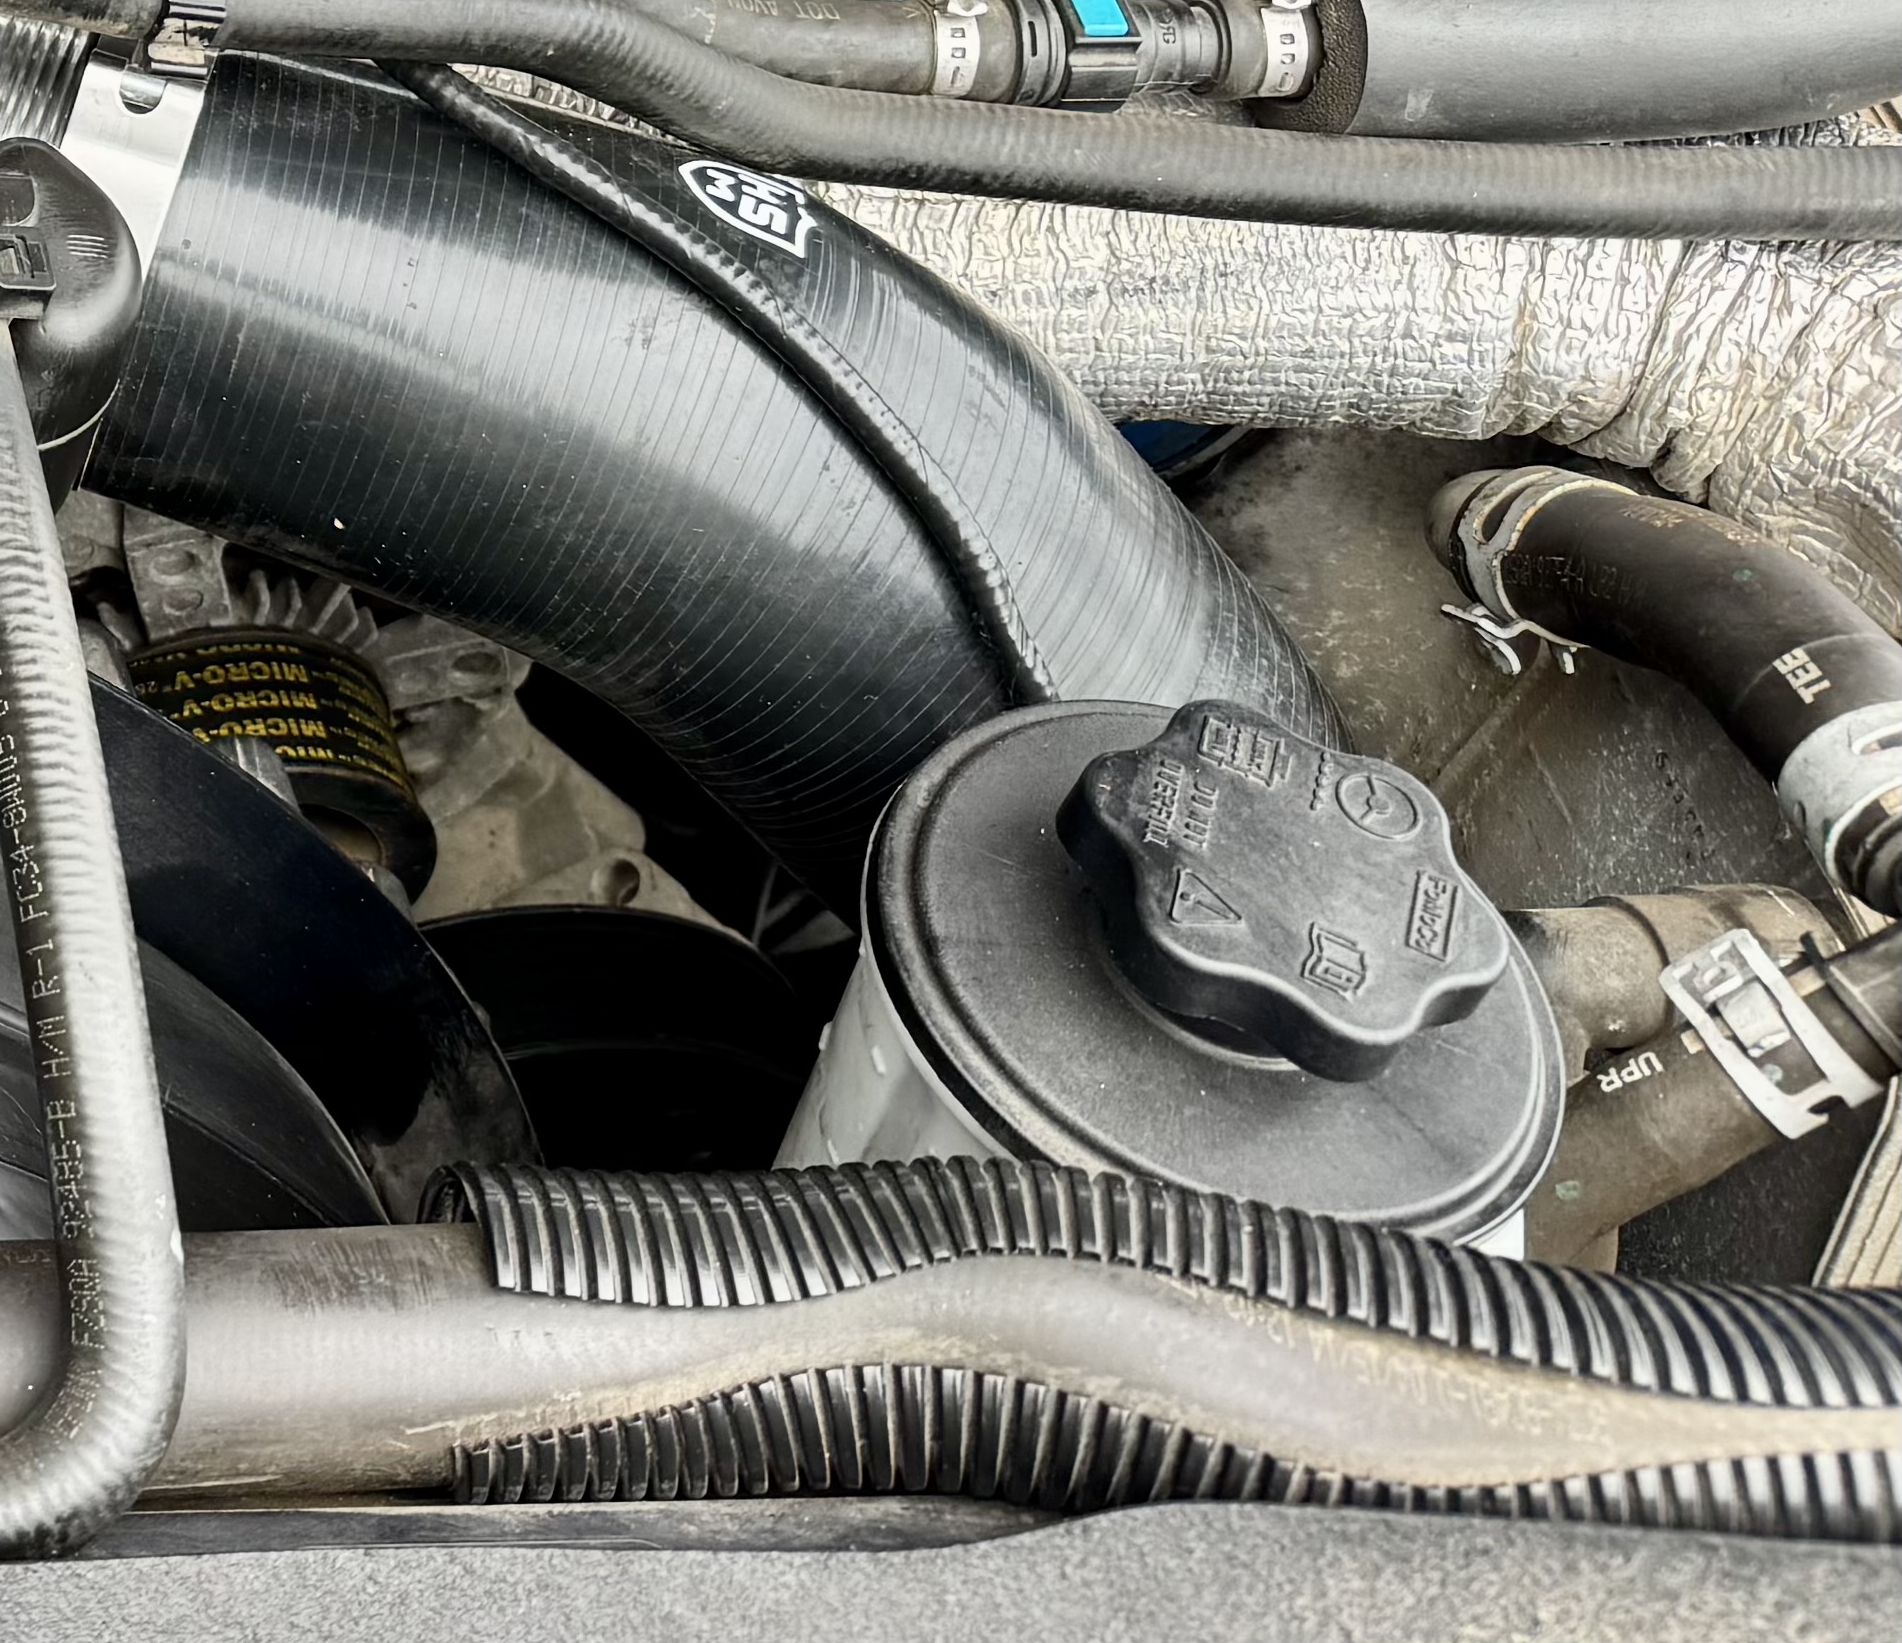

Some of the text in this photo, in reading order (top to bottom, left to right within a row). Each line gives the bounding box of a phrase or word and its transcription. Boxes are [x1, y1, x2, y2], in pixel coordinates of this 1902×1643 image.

[794, 1, 841, 21] DOT
[173, 660, 311, 692] MICRO-V
[1771, 647, 1833, 705] TEE
[181, 688, 319, 719] MICRO-V
[1413, 873, 1449, 954] FoMoCo
[24, 937, 63, 1000] R-1
[34, 1014, 73, 1079] H/M
[1596, 1051, 1666, 1093] UPR
